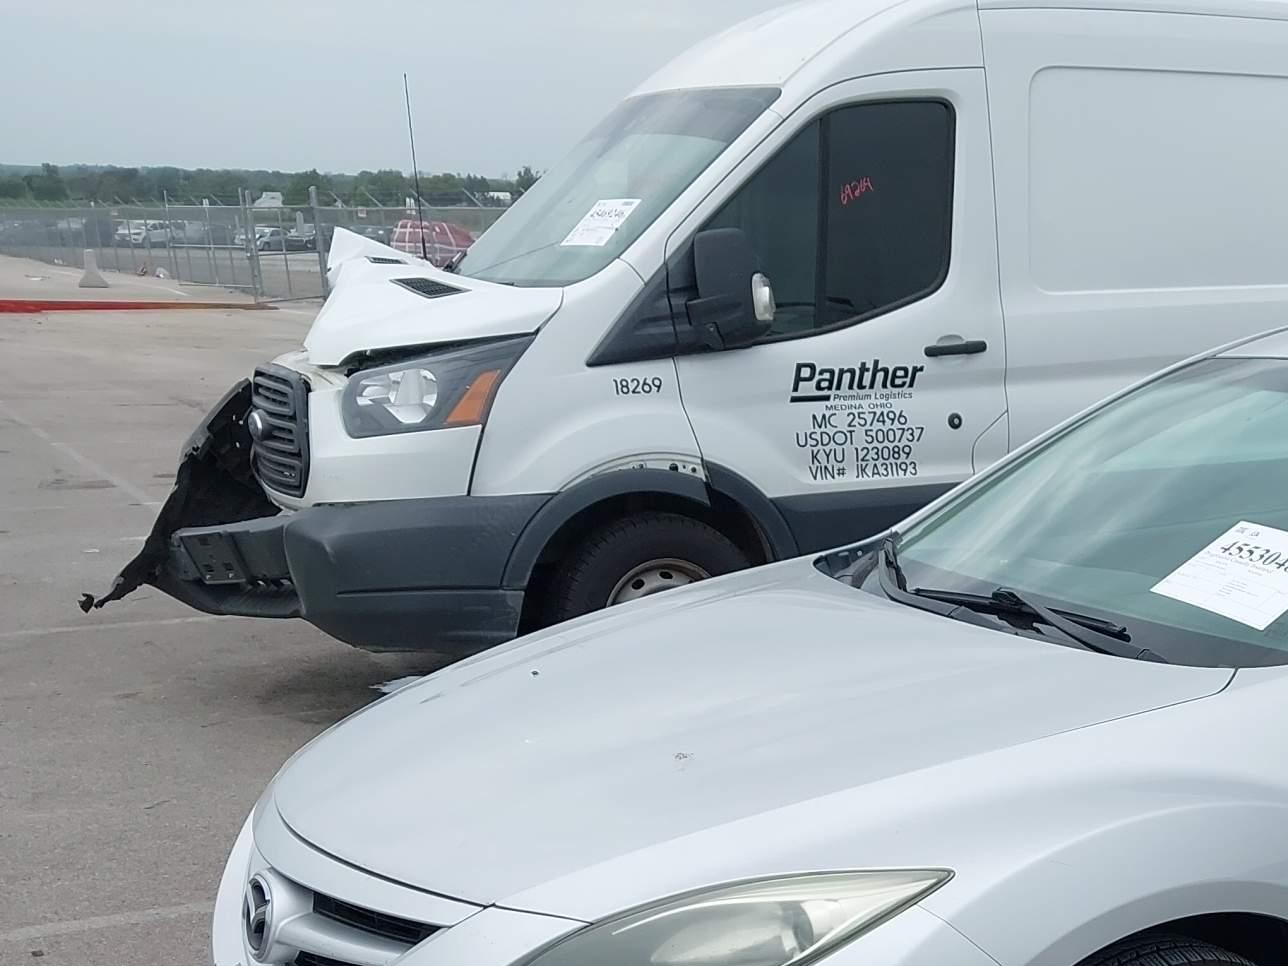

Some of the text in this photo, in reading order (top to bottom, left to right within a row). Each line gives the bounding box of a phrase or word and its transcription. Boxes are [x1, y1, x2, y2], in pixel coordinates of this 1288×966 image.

[792, 359, 924, 392] Panther
[612, 376, 662, 395] 18269
[833, 391, 912, 401] Premium Logistics
[825, 401, 892, 411] MEDINA OHIO
[812, 410, 907, 429] MC 257496
[796, 427, 924, 447] USDOT 500737
[811, 445, 911, 465] KYU 123089
[808, 461, 918, 480] VIN# JKA31193
